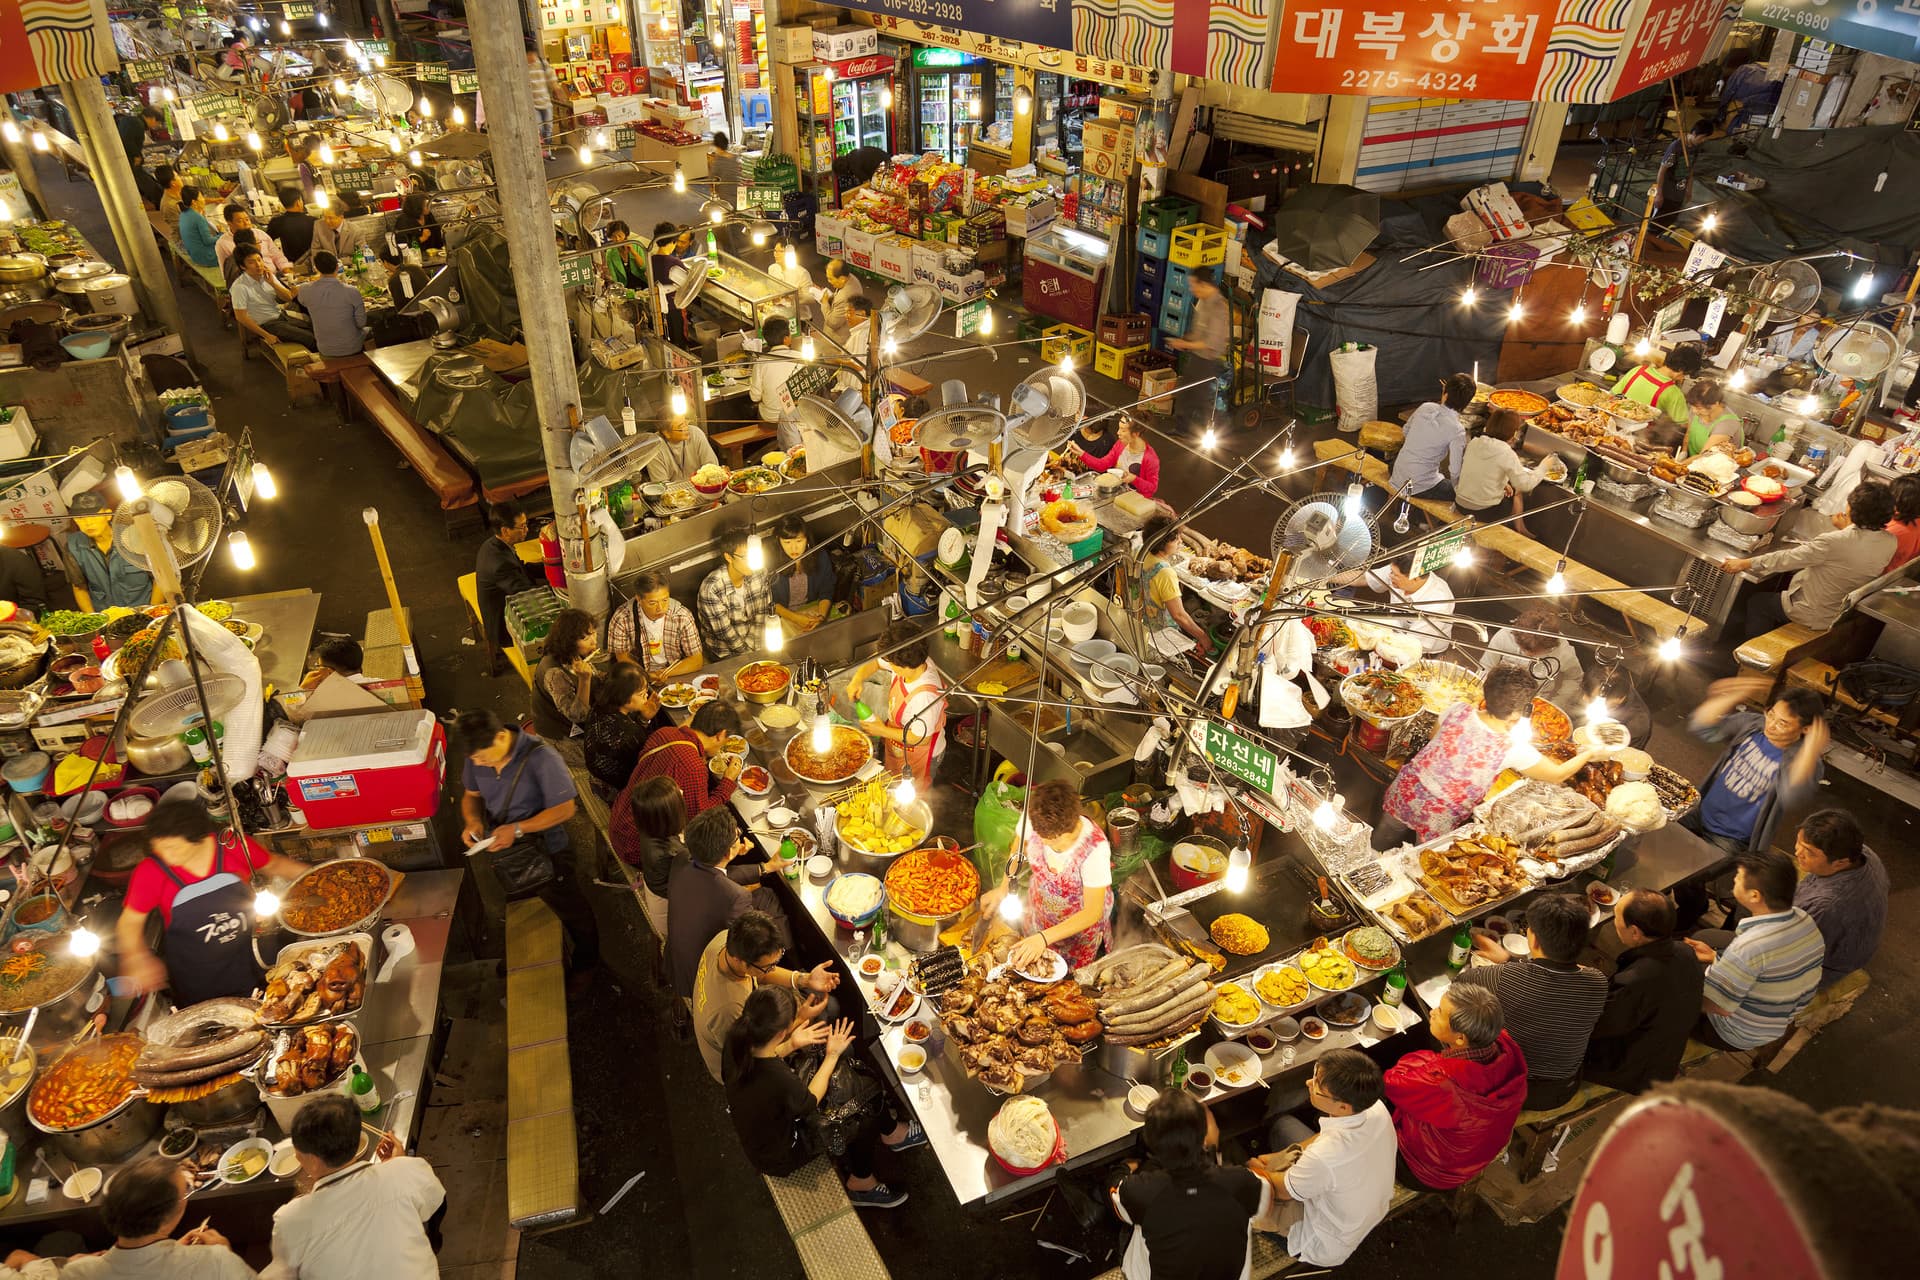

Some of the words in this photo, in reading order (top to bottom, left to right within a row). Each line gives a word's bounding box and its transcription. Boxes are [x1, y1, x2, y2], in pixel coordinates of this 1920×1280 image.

[1294, 9, 1539, 64] 대복상회
[1637, 0, 1724, 60] 대복상회
[1762, 4, 1830, 31] 2272-6980
[1341, 69, 1478, 92] 2275-4324
[1210, 728, 1272, 776] 자선네
[1215, 753, 1268, 788] 2263-2845
